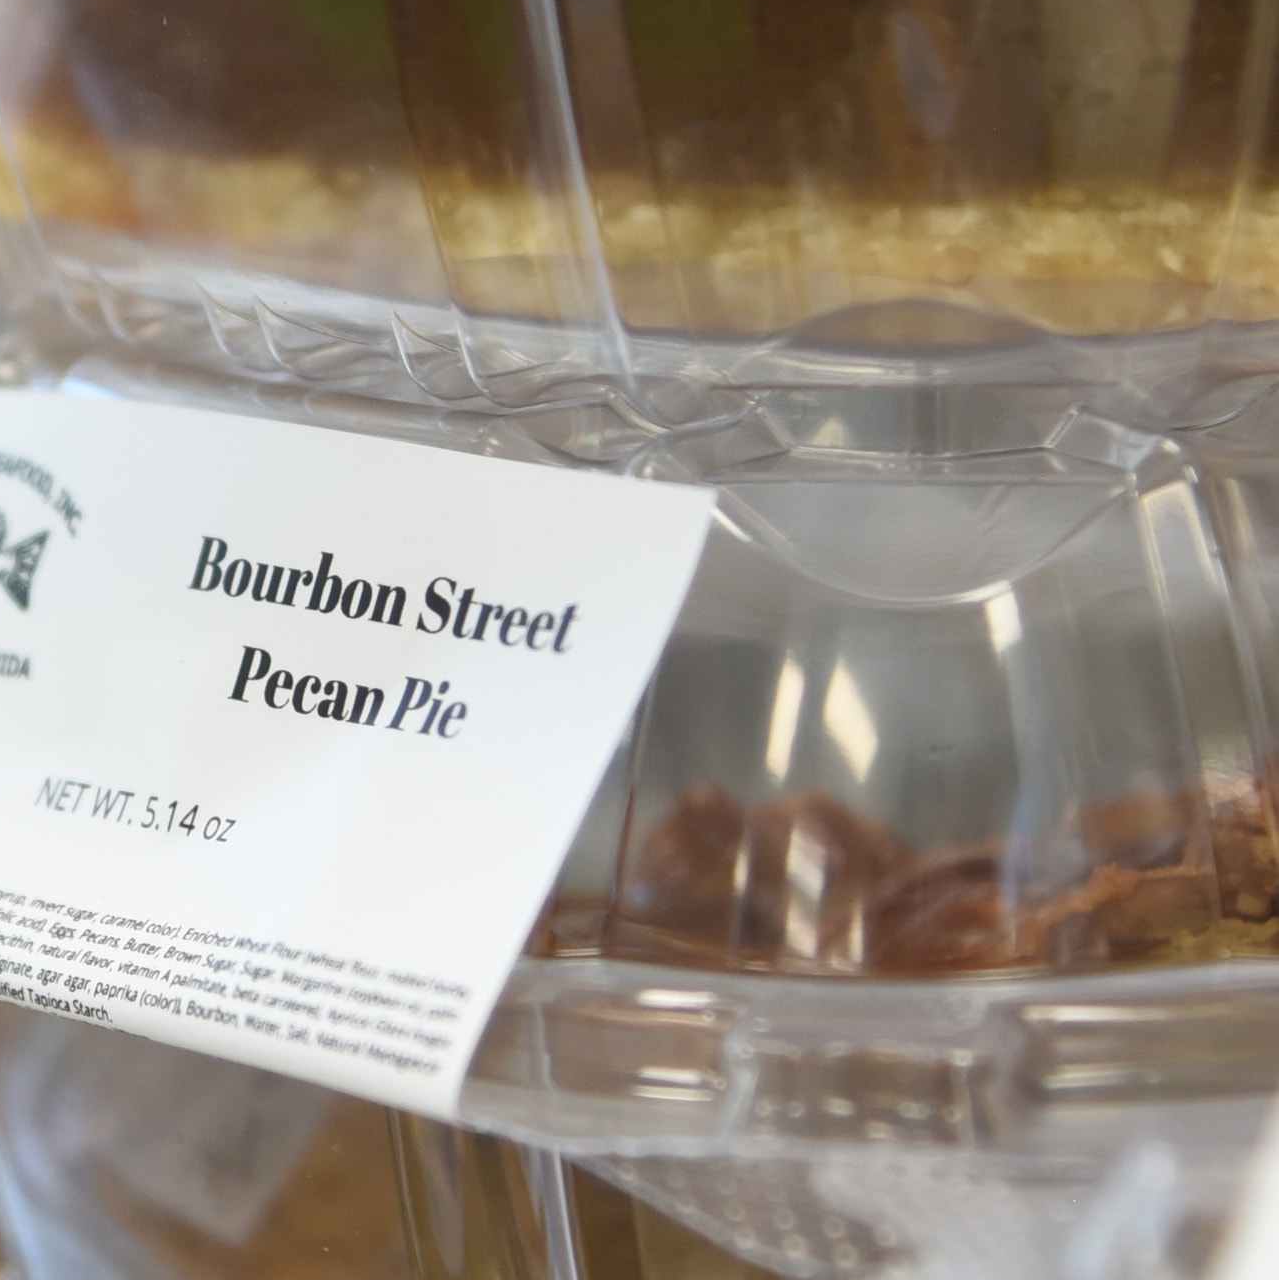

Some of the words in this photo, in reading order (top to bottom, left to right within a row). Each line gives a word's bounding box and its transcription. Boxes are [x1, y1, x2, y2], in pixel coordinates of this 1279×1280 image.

[188, 535, 407, 628] Bourbon
[415, 576, 580, 655] Street
[228, 645, 386, 728] Pecan
[386, 675, 468, 739] Pie
[34, 776, 92, 813] NET
[91, 786, 134, 827] WT.
[141, 795, 201, 838] 5.14
[203, 816, 237, 843] oz
[29, 896, 65, 915] invert
[62, 906, 99, 924] sugar,
[99, 914, 149, 932] caramel
[181, 926, 235, 949] Enriched
[78, 928, 121, 951] Pecans,
[122, 937, 163, 960] Butter,
[163, 945, 202, 966] Brown
[36, 942, 83, 963] natural
[79, 949, 116, 973] flavor,
[117, 960, 161, 982] vitamin
[160, 967, 173, 984] A
[25, 987, 72, 1014] Tapioca
[71, 998, 113, 1024] Starch.
[36, 966, 64, 987] agar
[63, 973, 93, 996] agar,
[93, 980, 139, 1004] paprika
[185, 999, 240, 1030] Bourbon,
